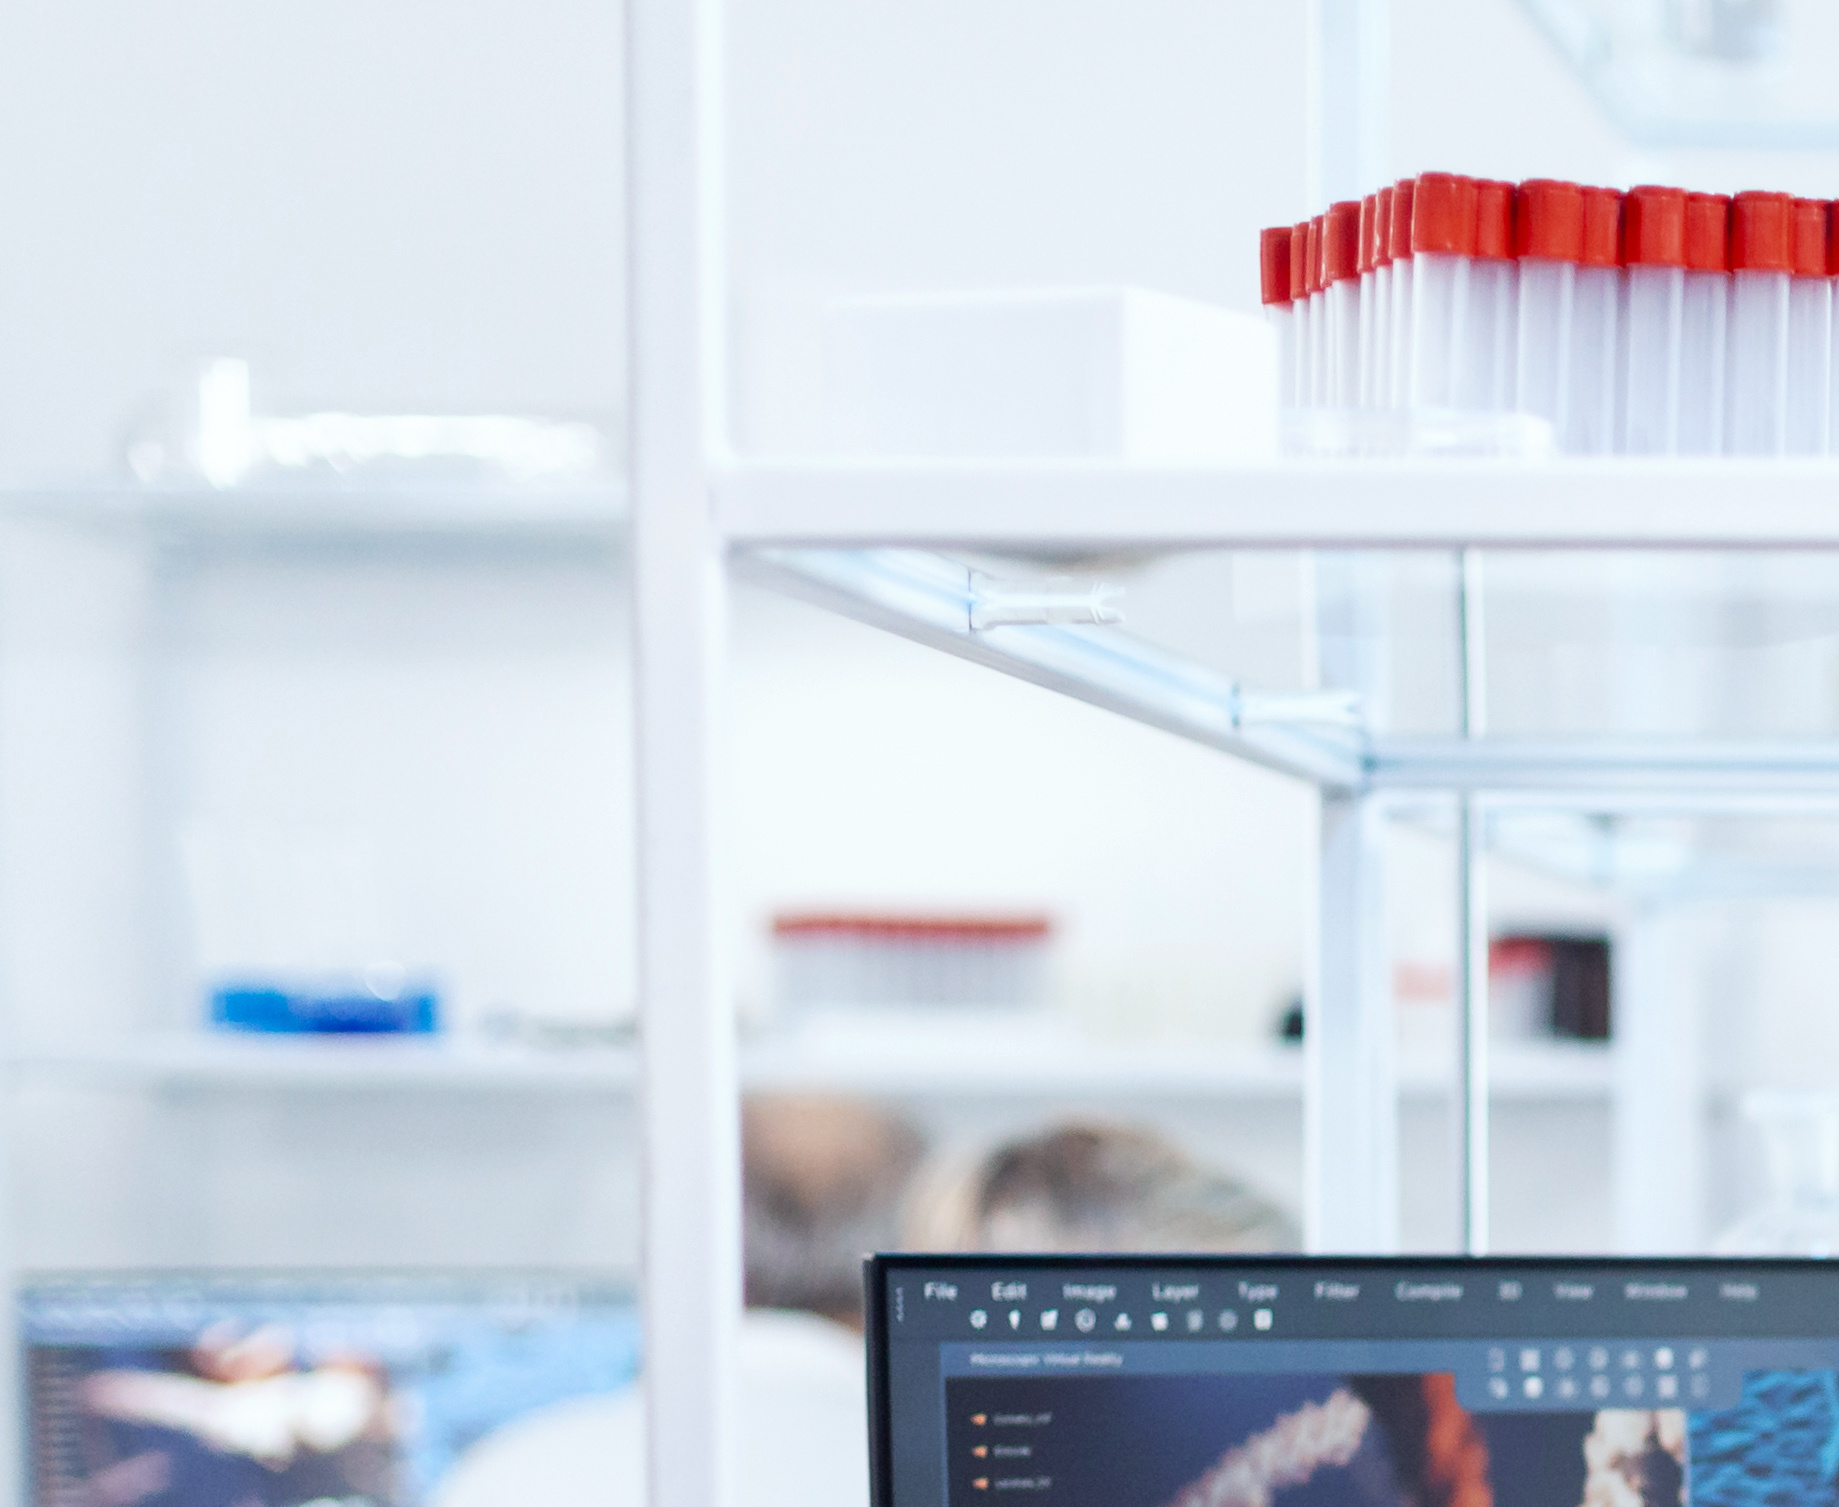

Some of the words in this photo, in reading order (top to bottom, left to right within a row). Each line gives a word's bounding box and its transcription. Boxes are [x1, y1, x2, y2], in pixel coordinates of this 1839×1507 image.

[923, 1281, 958, 1300] File
[991, 1281, 1028, 1300] Edit
[1062, 1283, 1117, 1303] Image
[1152, 1282, 1200, 1303] Layer
[1238, 1281, 1279, 1302] Type
[1314, 1281, 1360, 1300] Filter
